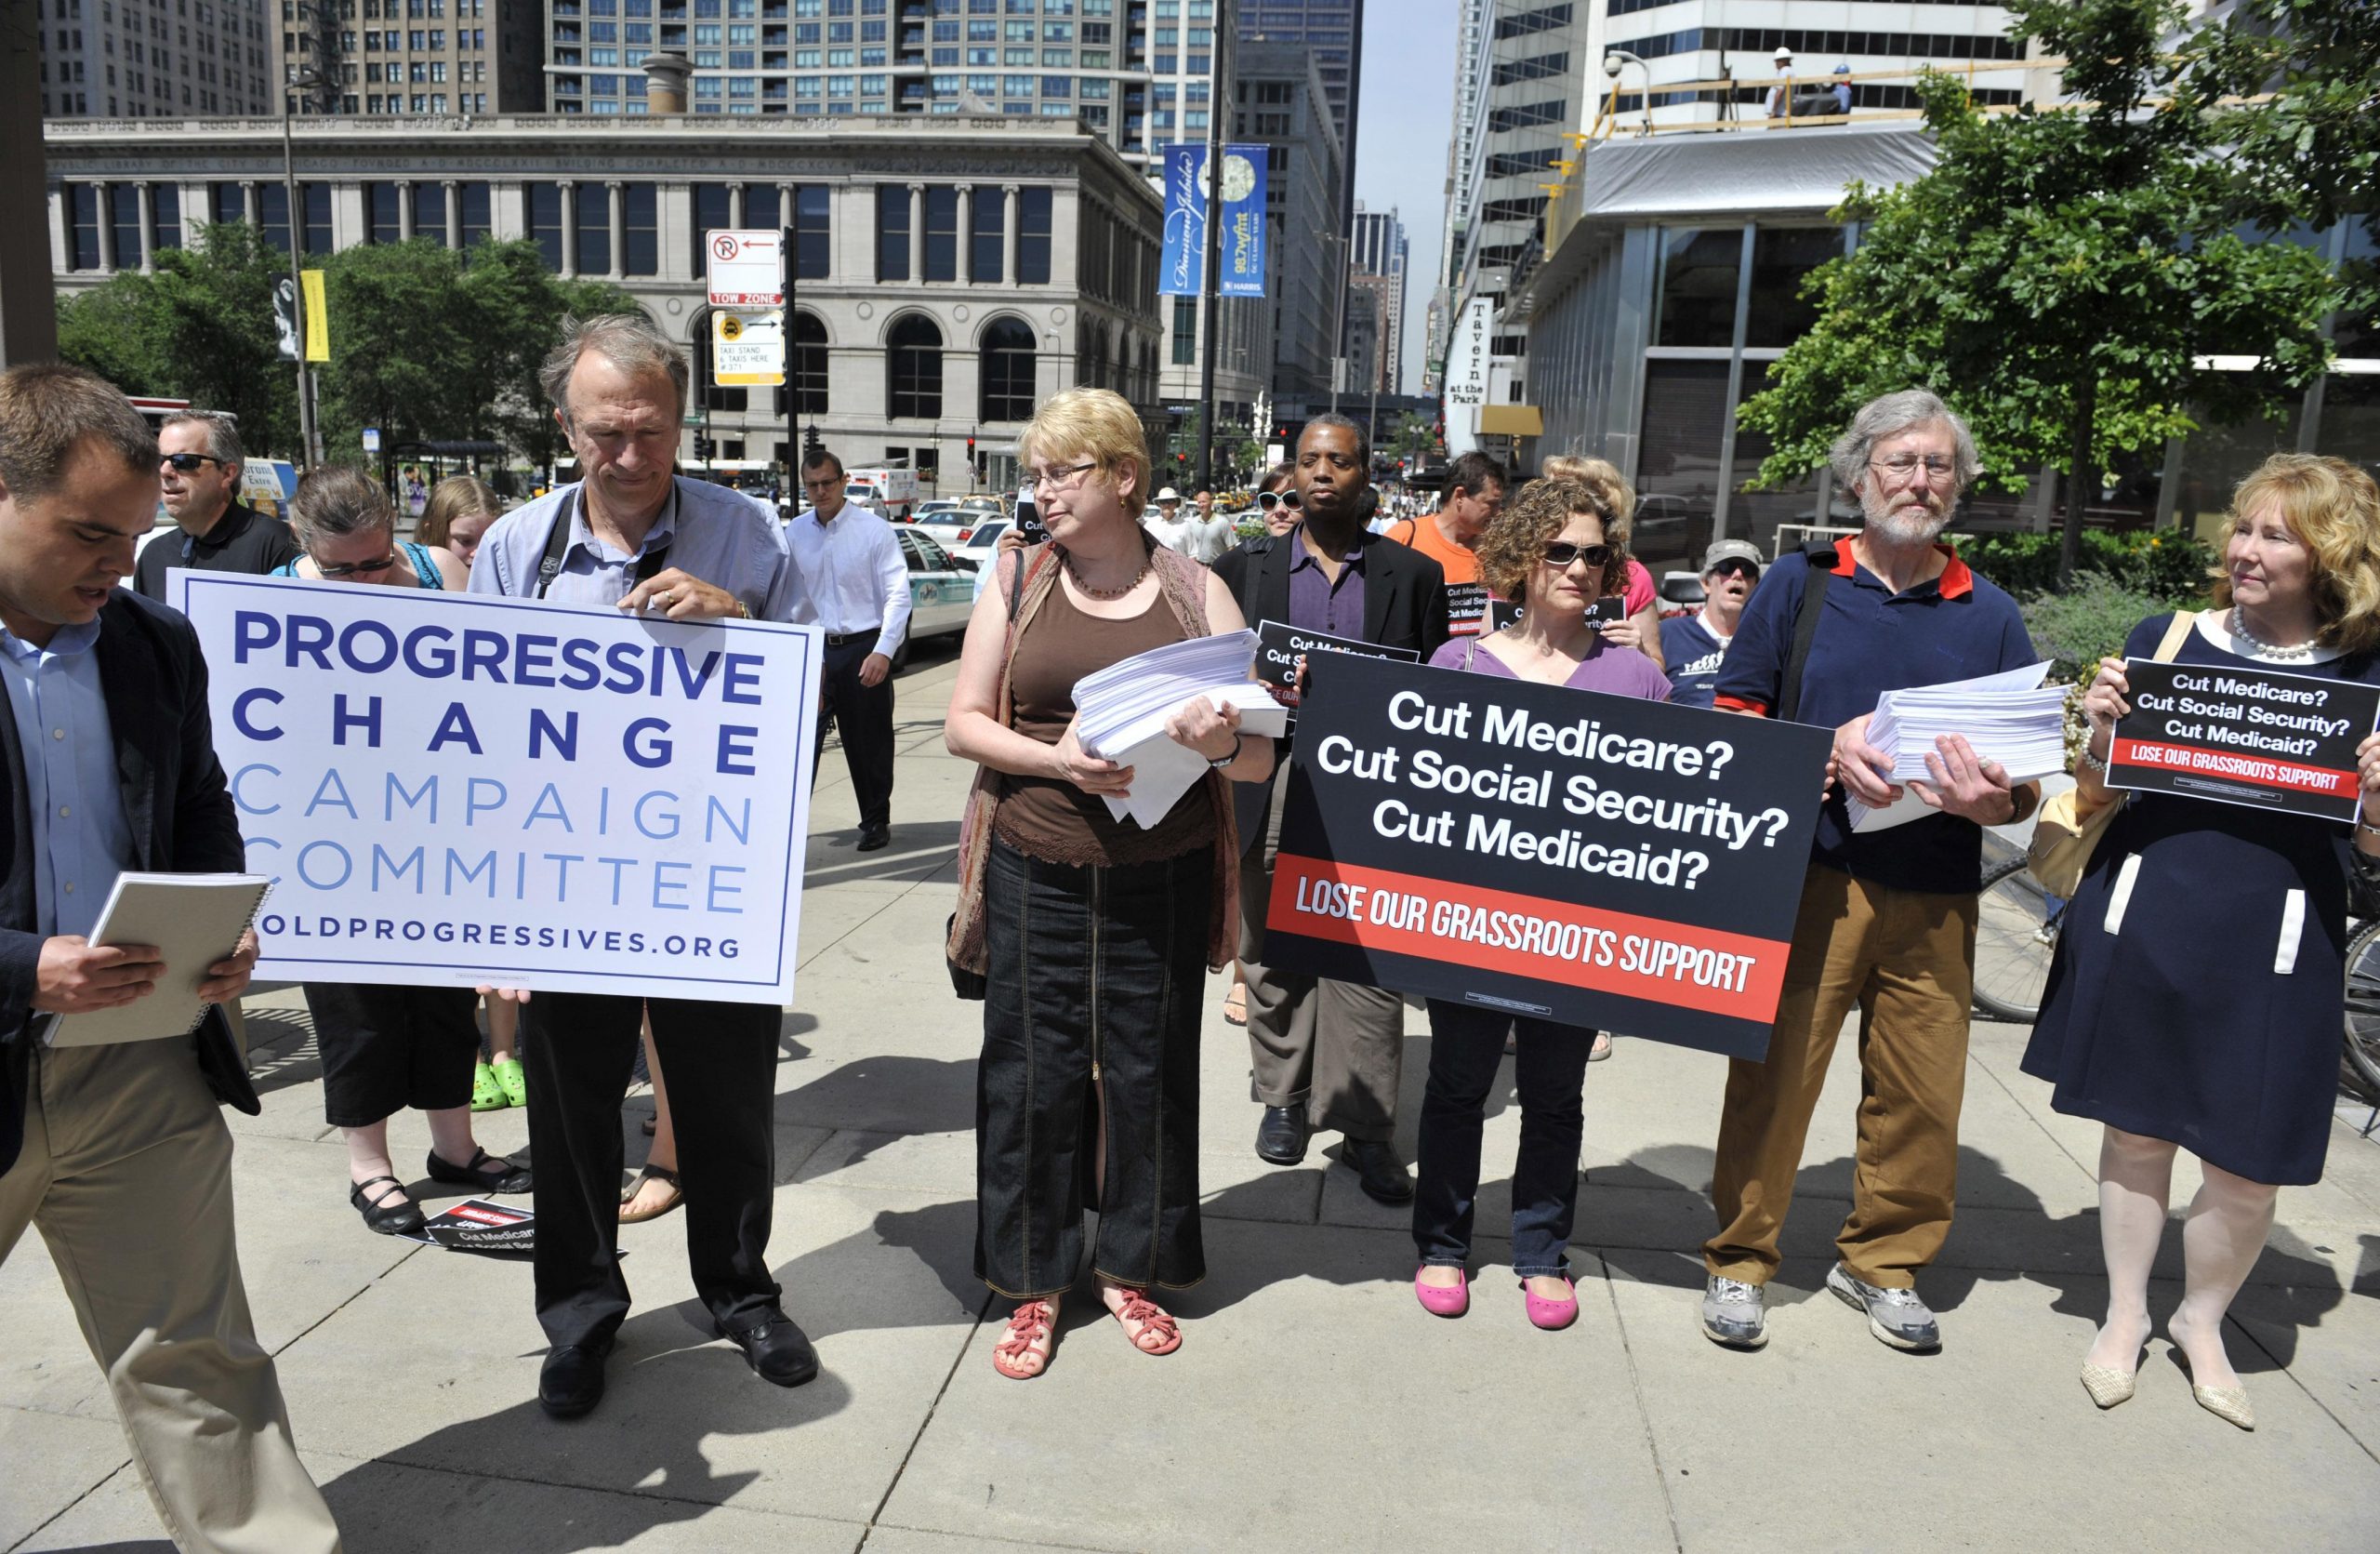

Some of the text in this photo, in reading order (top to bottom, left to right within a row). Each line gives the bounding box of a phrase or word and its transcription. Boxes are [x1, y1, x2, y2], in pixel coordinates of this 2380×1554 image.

[1168, 152, 1202, 289] Diamond Jubilee
[714, 293, 777, 304] TOW ZONE
[1233, 282, 1262, 291] HARRIS
[739, 346, 761, 354] STAND
[1469, 304, 1486, 380] Tavern
[1449, 383, 1484, 394] at the
[1452, 394, 1480, 404] Park
[233, 609, 765, 707] PROGRESSIVE
[1266, 649, 1291, 666] Cut
[2172, 673, 2329, 707] Cut Medicare?
[231, 686, 760, 777] CHANGE
[1388, 691, 1734, 780] Cut Medicare?
[2136, 693, 2350, 737] Cut Social Security?
[2164, 719, 2318, 756] Cut Medicaid?
[2131, 744, 2163, 763] LOSE
[2163, 748, 2191, 767] OUR
[2191, 751, 2277, 780] GRASSROOTS
[2277, 765, 2340, 790] SUPPORT
[231, 763, 751, 845] CAMPAIGN
[1317, 735, 1790, 851] Cut Social Security?
[1373, 799, 1710, 891] Cut Medicaid?
[260, 913, 739, 959] OLDPROGRESSIVES.ORG
[1295, 876, 1756, 993] LOSE OUR GRASSROOTS SUPPORT
[458, 1231, 483, 1242] Cut
